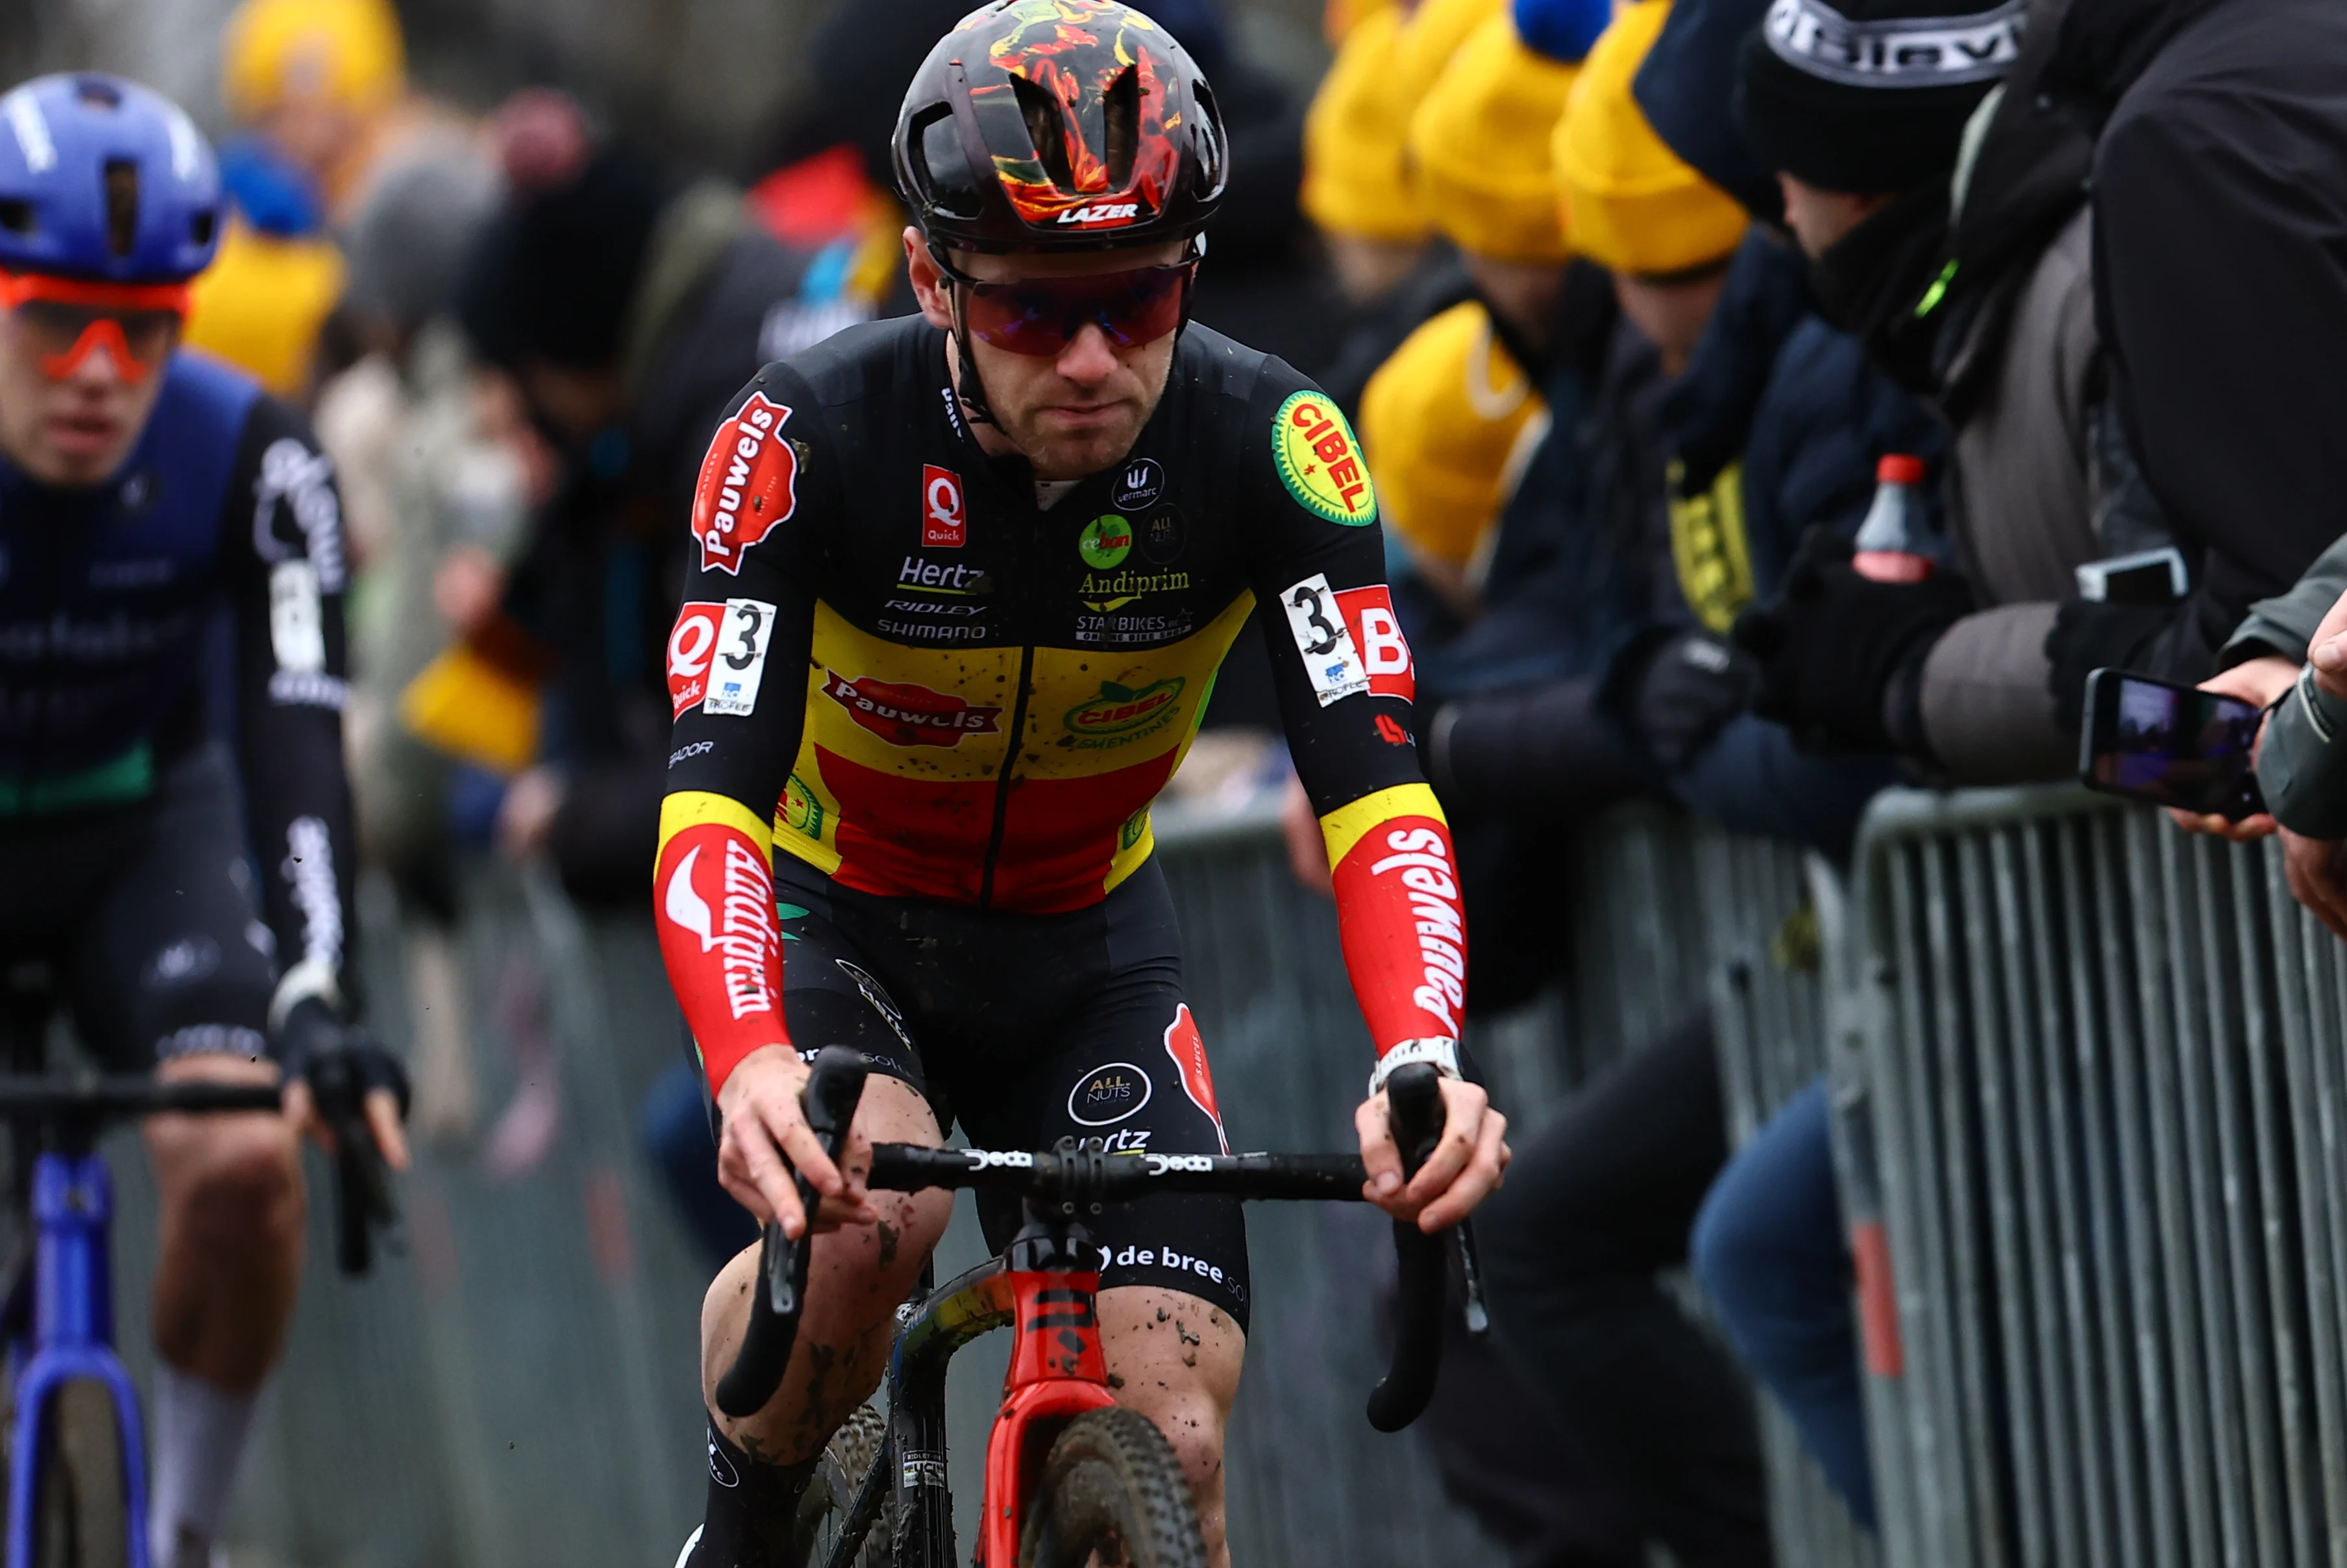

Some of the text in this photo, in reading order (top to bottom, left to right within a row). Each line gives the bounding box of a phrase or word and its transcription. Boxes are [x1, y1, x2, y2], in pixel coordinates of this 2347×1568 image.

[1057, 203, 1139, 223] LAZER
[1292, 403, 1364, 513] CIBEL
[705, 408, 773, 557] Pauwels
[1118, 487, 1157, 503] vermarc
[928, 530, 959, 541] Quick
[1078, 567, 1190, 599] Andiprim
[885, 600, 987, 616] RIDLEY
[1294, 586, 1337, 655] 3
[726, 604, 762, 670] 3
[877, 619, 987, 639] SHIMANO
[673, 680, 701, 709] Quick
[835, 682, 985, 728] Pauwels
[1077, 692, 1174, 725] CIBEL
[723, 839, 778, 1021] Andiprim
[1371, 827, 1465, 1039] Pauwels
[1192, 1035, 1203, 1077] SAUCES
[1087, 1086, 1131, 1104] NUTS
[1116, 1245, 1155, 1266] de
[1162, 1246, 1223, 1284] bree
